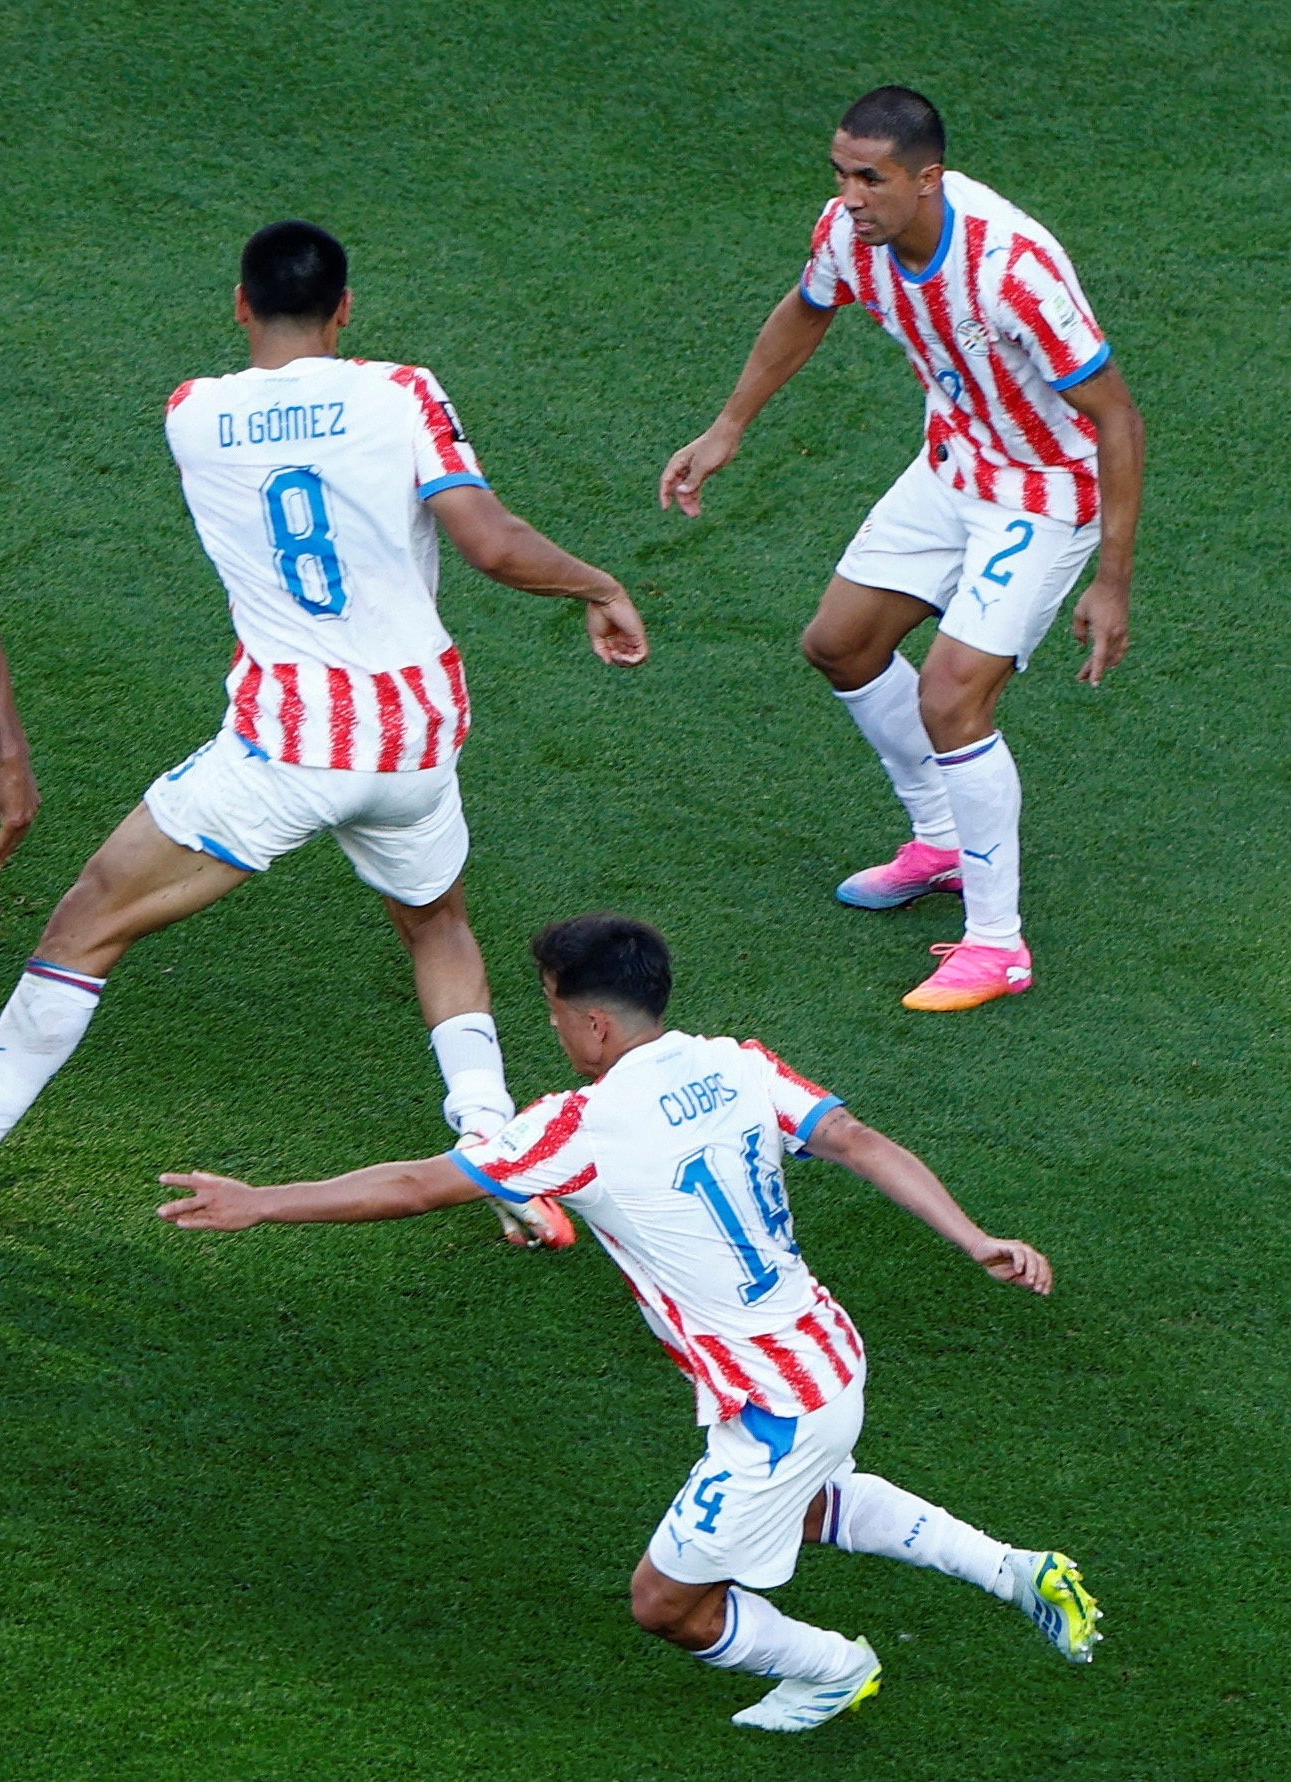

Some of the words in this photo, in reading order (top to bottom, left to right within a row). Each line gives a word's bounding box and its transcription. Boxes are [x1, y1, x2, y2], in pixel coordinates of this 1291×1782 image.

[219, 413, 242, 448] D.
[248, 402, 346, 444] GÓMEZ
[261, 465, 350, 620] 8
[981, 519, 1034, 587] 2
[659, 1072, 738, 1127] CUBAS
[674, 1125, 802, 1307] 14
